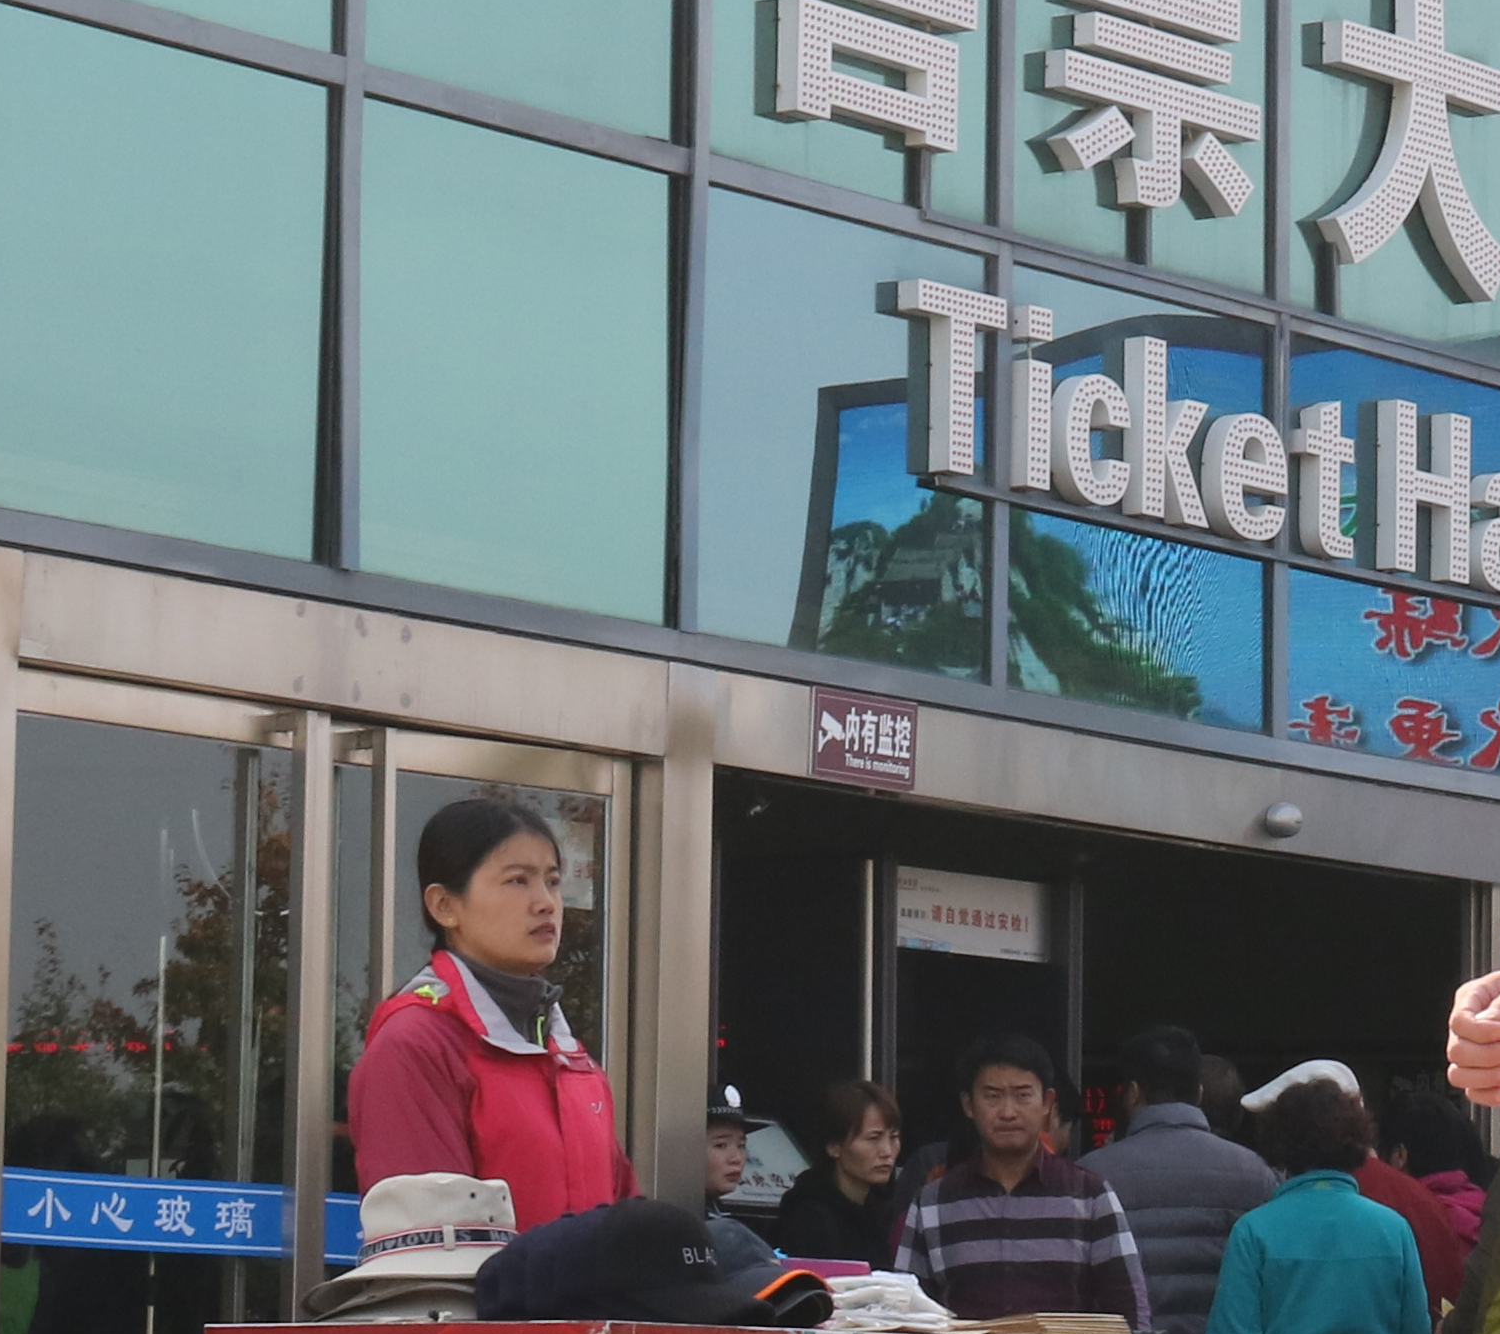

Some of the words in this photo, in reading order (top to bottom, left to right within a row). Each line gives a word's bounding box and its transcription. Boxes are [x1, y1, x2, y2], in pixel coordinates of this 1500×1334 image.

[882, 277, 1356, 562] Ticket
[844, 707, 912, 759] 内有监控
[845, 753, 865, 769] There
[865, 756, 872, 770] is
[872, 760, 910, 780] monitoring
[27, 1187, 256, 1240] 小心玻璃
